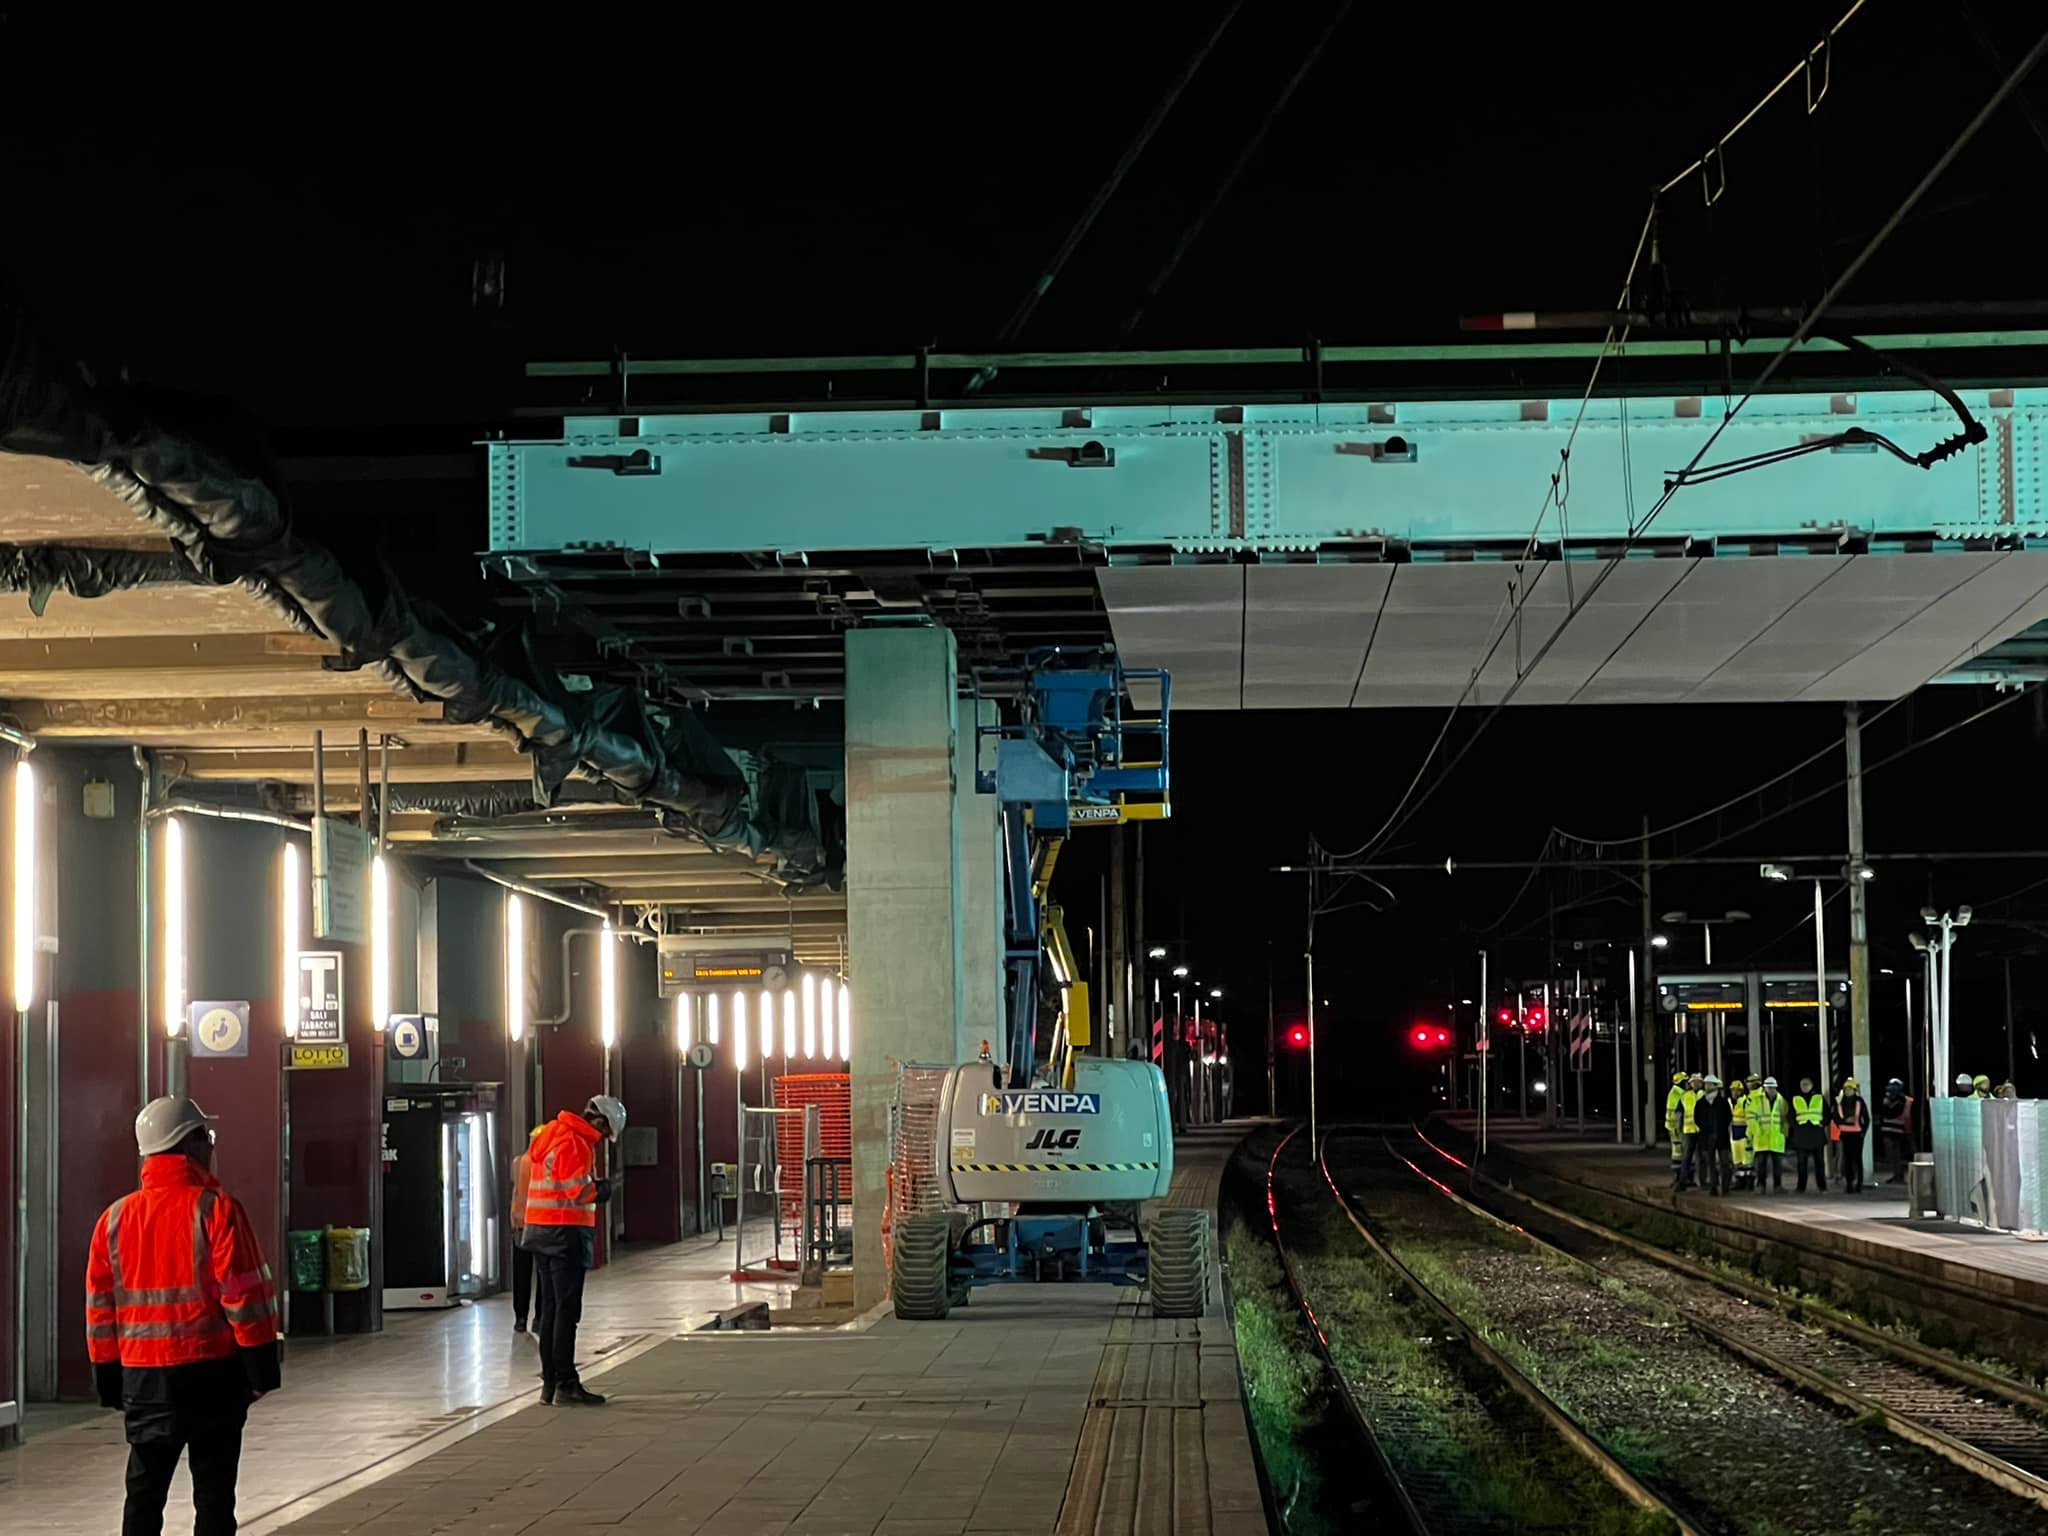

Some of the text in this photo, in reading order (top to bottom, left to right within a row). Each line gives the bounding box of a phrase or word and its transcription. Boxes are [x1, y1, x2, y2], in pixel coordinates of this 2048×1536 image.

[1077, 808, 1119, 819] VENPA
[300, 958, 336, 1010] T
[300, 1020, 337, 1030] TABACCHI
[294, 1048, 344, 1060] LOTTO
[1004, 1094, 1097, 1113] VENPA
[1025, 1129, 1081, 1149] JLG
